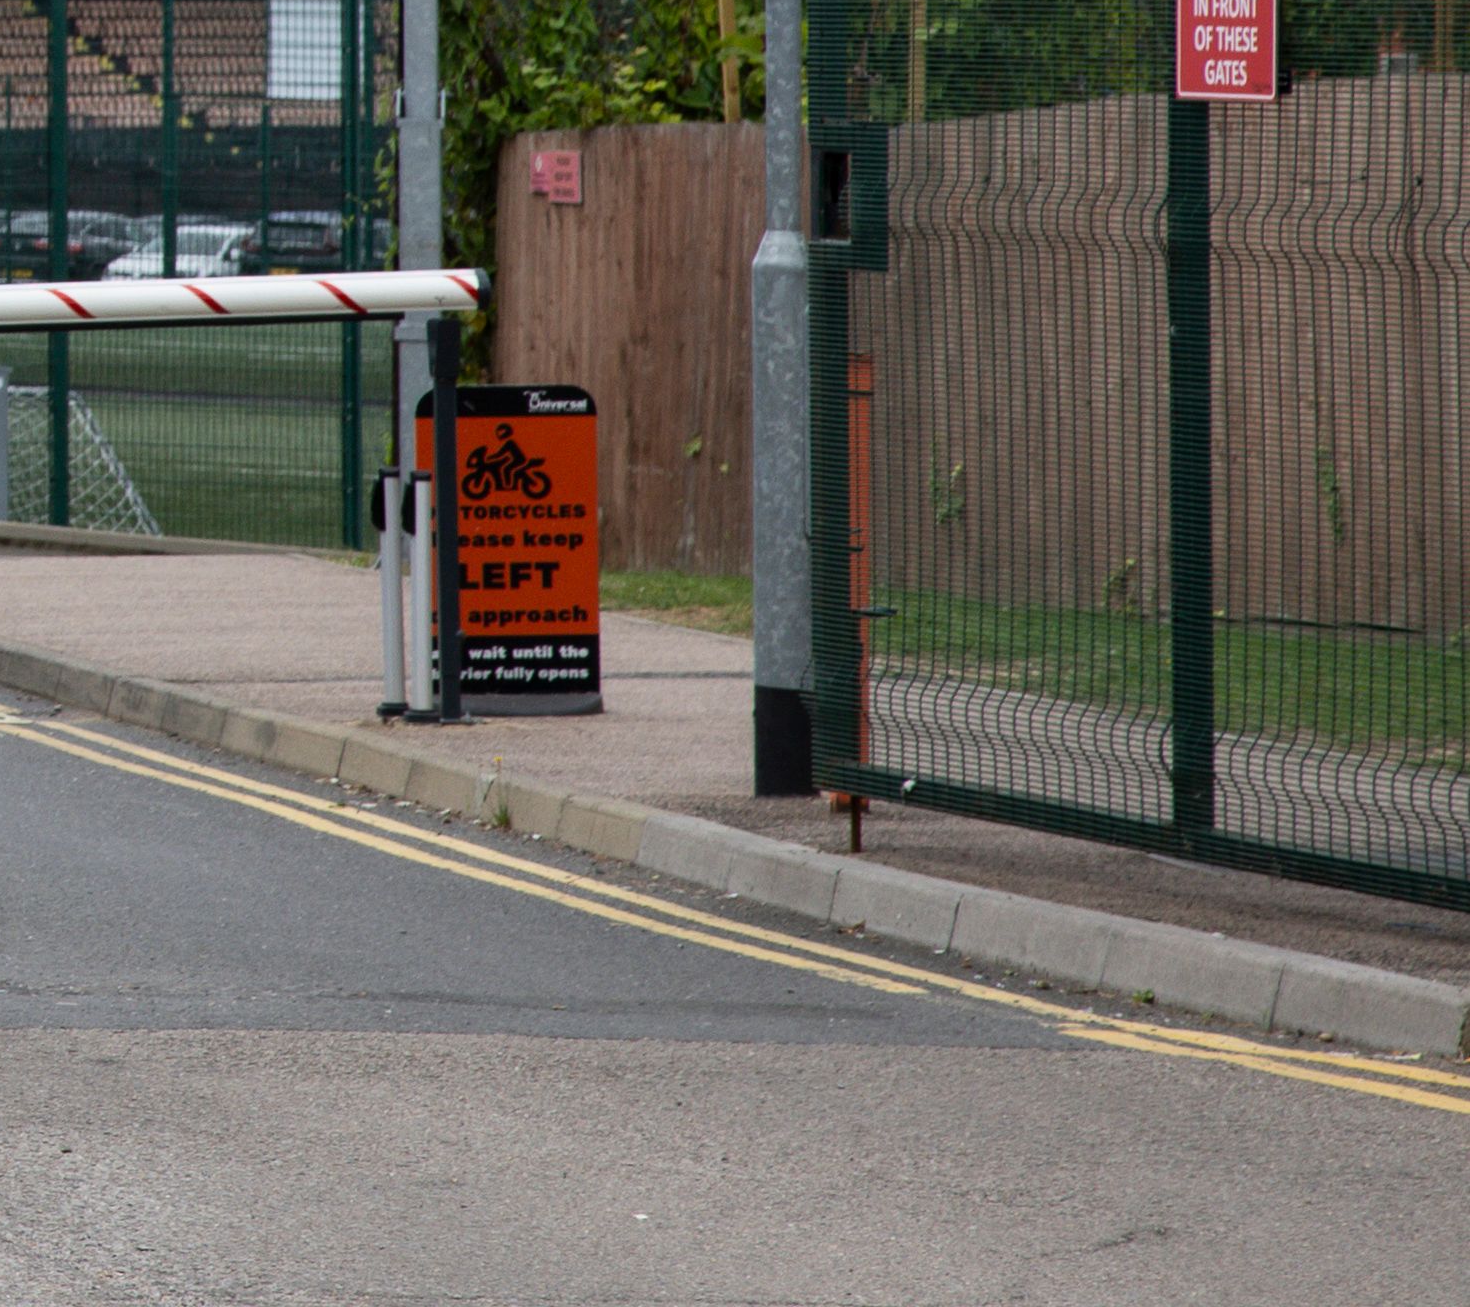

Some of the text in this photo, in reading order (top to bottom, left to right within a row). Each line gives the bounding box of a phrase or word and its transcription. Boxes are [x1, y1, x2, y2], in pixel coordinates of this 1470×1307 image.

[1194, 25, 1258, 53] OF THESE
[1204, 59, 1247, 86] GATES
[431, 504, 586, 519] TORCYCLES
[523, 529, 583, 550] keep
[458, 561, 560, 590] LEFT
[468, 605, 588, 627] approach
[468, 644, 589, 660] wait until the
[494, 666, 534, 682] fully
[538, 668, 589, 682] opens
